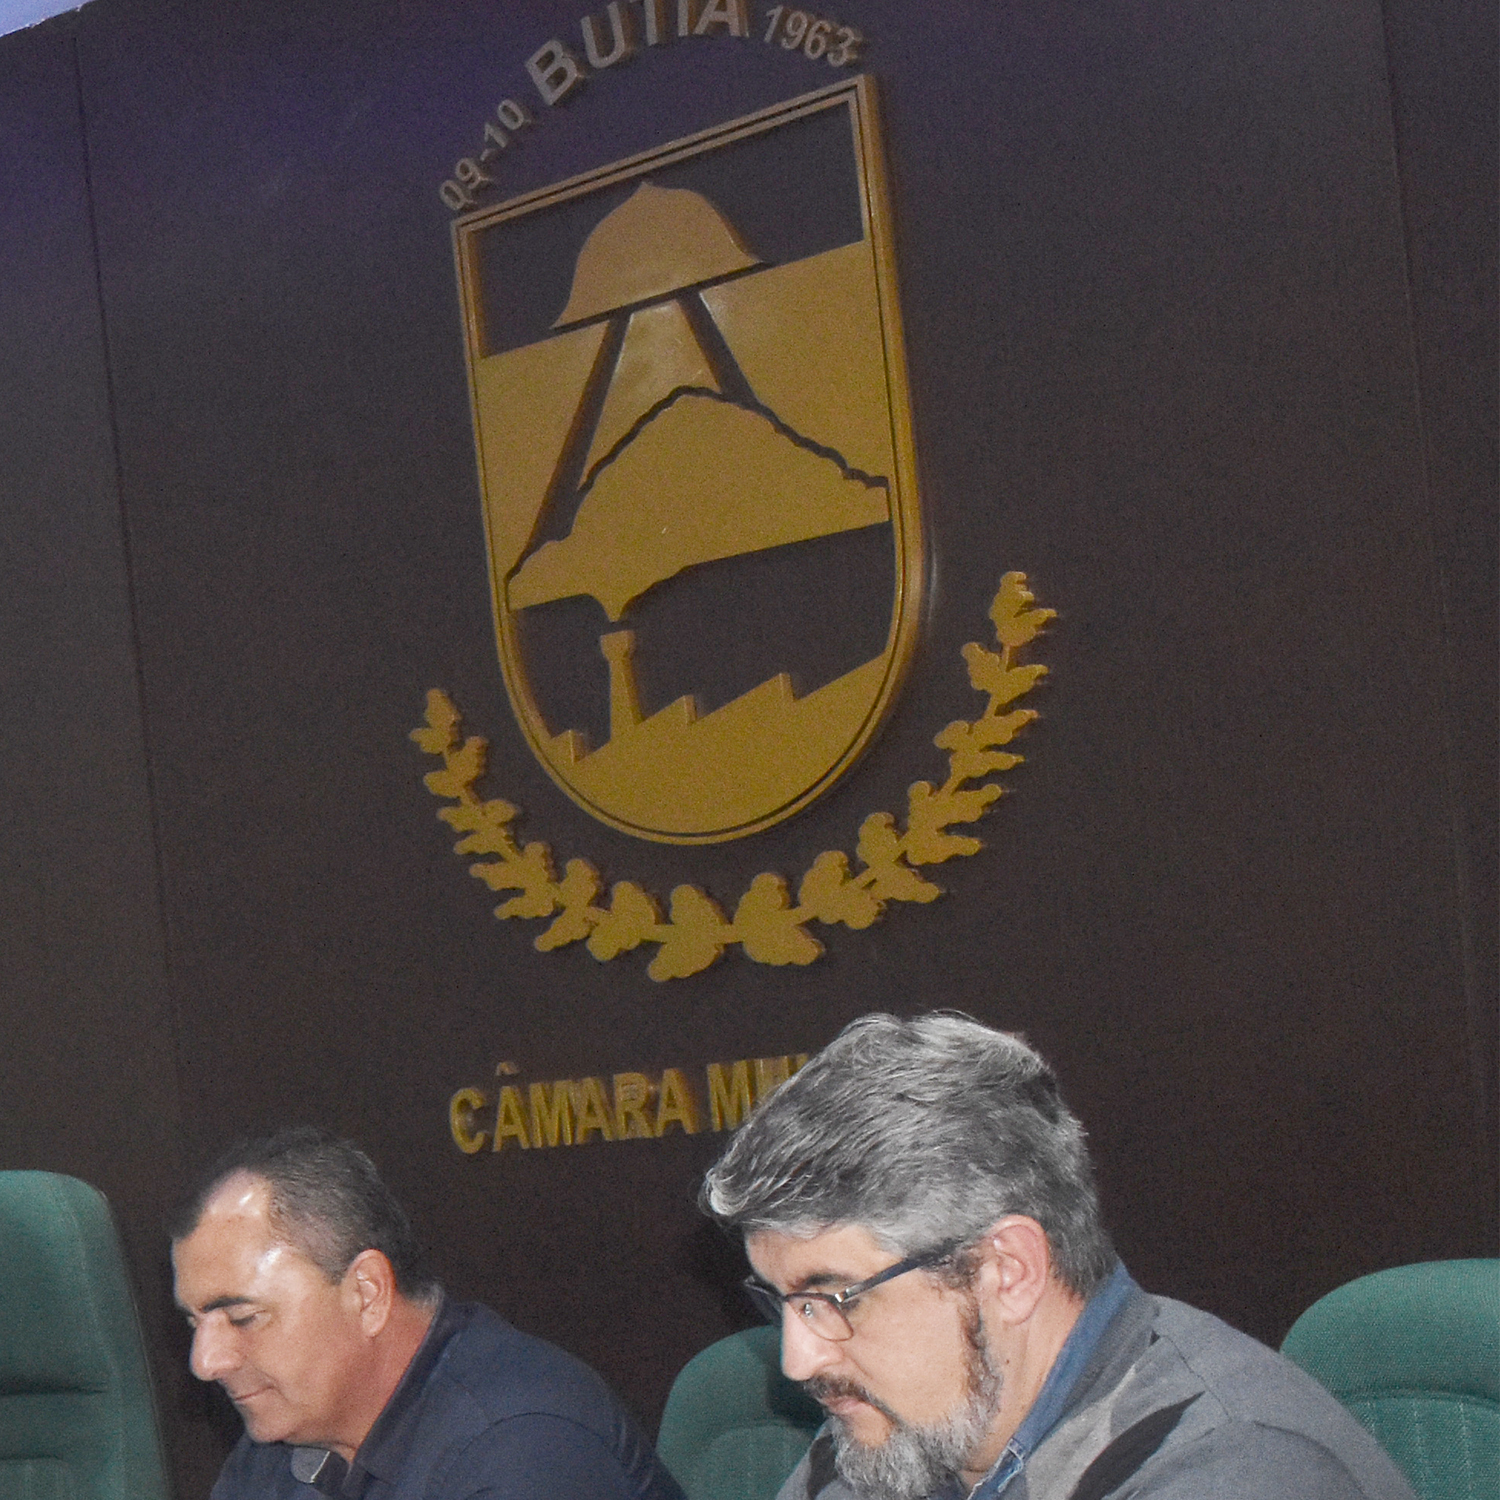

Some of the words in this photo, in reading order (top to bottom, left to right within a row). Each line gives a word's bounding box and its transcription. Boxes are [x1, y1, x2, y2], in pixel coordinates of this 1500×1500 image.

[439, 98, 528, 211] 09-10
[763, 4, 860, 68] 1963
[450, 1060, 700, 1154] CÂMARA
